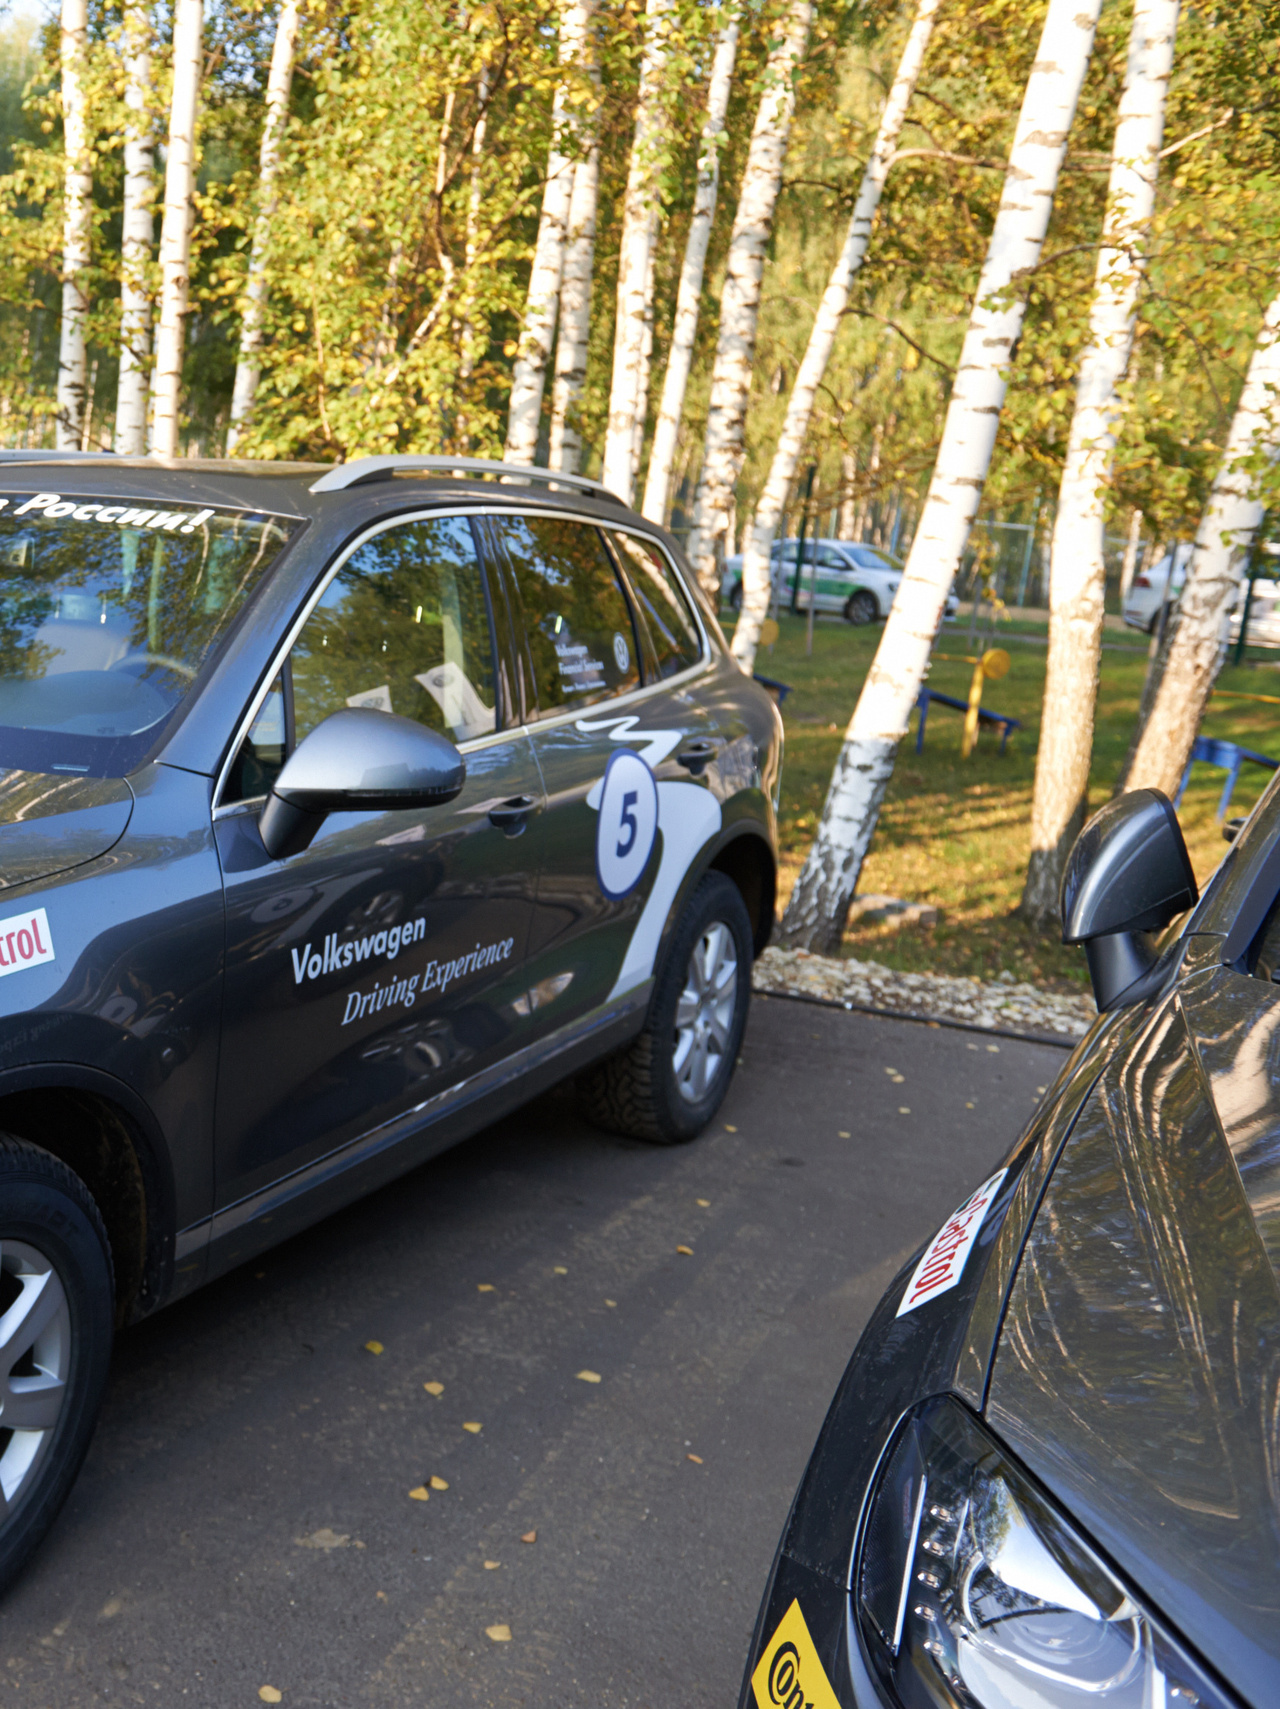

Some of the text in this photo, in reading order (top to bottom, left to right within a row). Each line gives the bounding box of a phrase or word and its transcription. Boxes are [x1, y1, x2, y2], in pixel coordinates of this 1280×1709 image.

[14, 493, 215, 534] России!
[616, 790, 638, 859] 5
[291, 916, 426, 985] Volkswagen
[341, 937, 514, 1026] Driving Experience
[908, 1197, 988, 1304] Castrol
